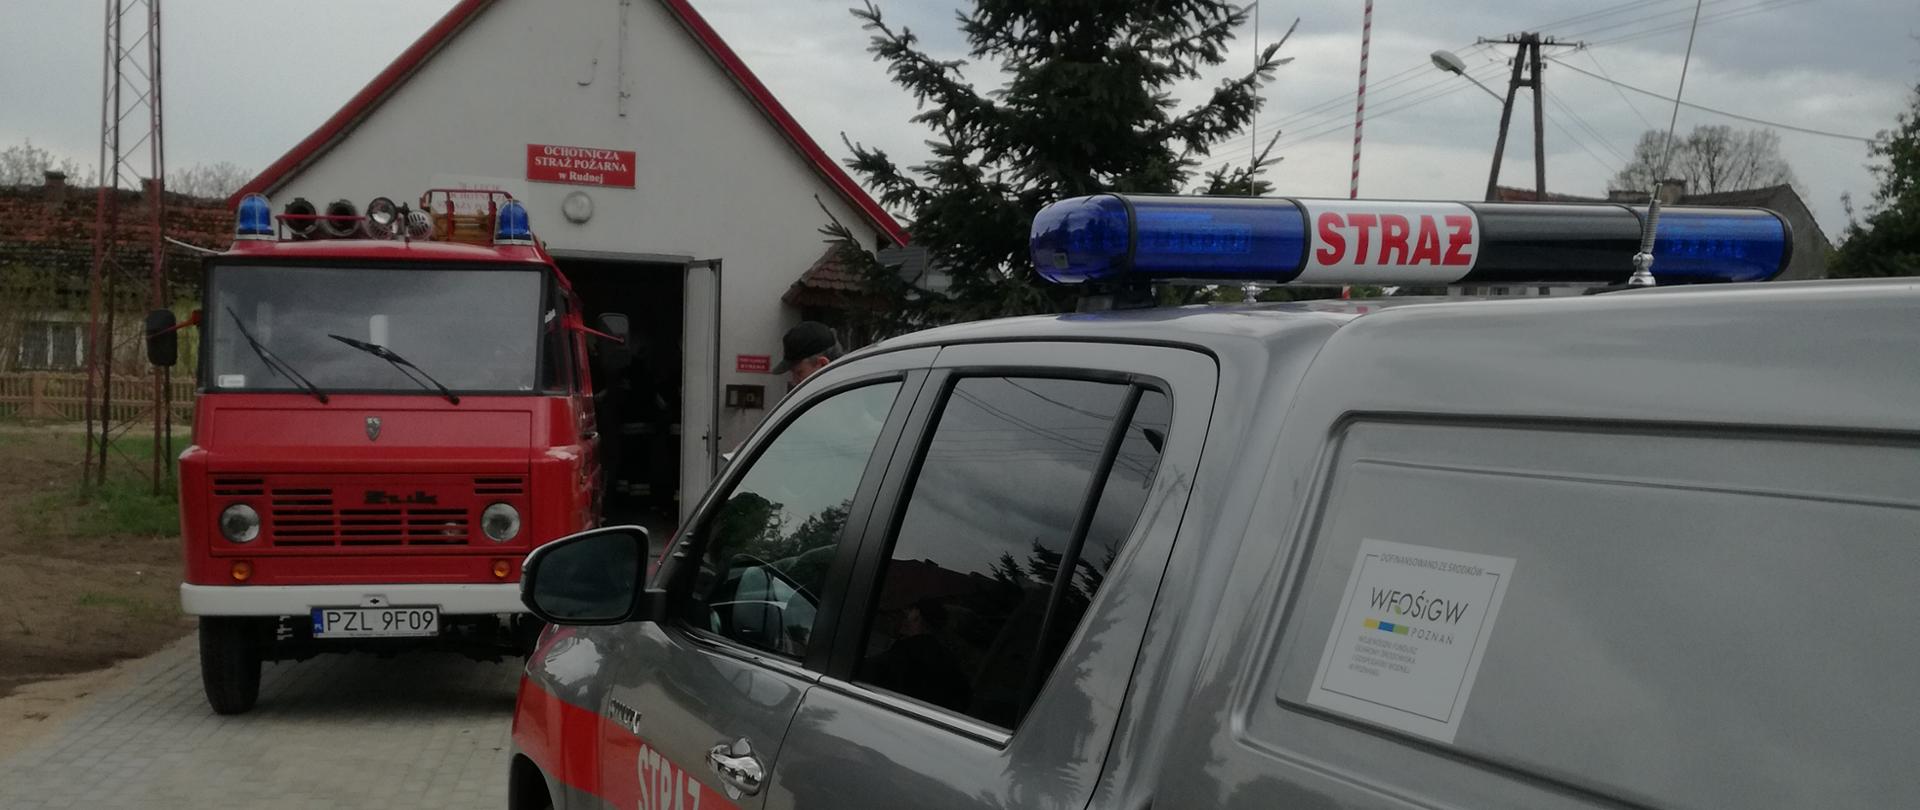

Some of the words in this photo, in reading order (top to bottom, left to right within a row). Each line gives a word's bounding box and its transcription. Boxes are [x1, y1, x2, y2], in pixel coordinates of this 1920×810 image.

[544, 145, 619, 160] OCHOTNICZA
[535, 156, 571, 168] STRAŻ
[574, 159, 627, 172] POŻARNA
[569, 171, 603, 184] Rudnej
[326, 611, 373, 631] PZL
[382, 610, 434, 631] 9F09
